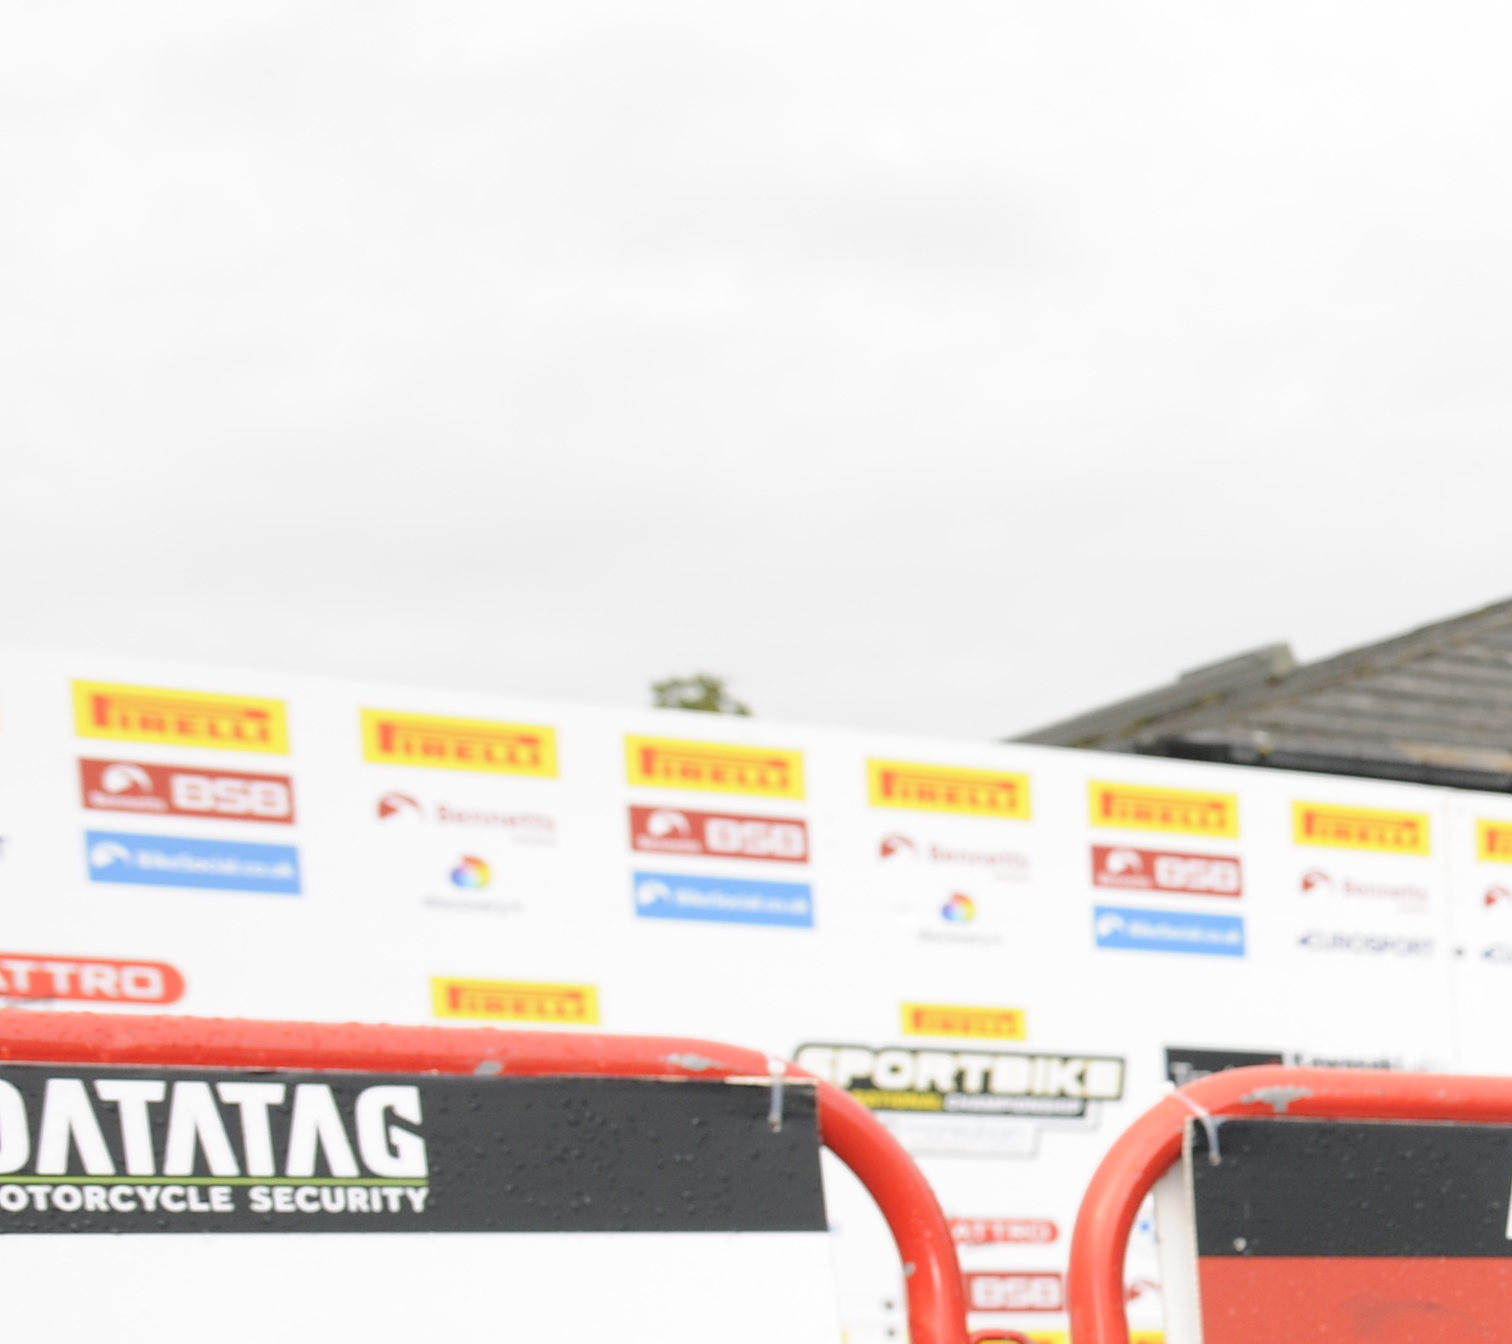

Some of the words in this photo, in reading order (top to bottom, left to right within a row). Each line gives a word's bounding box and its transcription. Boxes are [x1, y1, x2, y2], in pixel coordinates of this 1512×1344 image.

[91, 692, 270, 744] PIRELLI
[378, 721, 541, 768] PIRELLI
[641, 746, 789, 790] PIRELLI
[170, 773, 291, 817] BSB
[881, 770, 1016, 811] PIRELLI
[1102, 791, 1226, 829] PIRELLI
[446, 985, 586, 1018] PIRELLI
[249, 1186, 428, 1213] SECURITY
